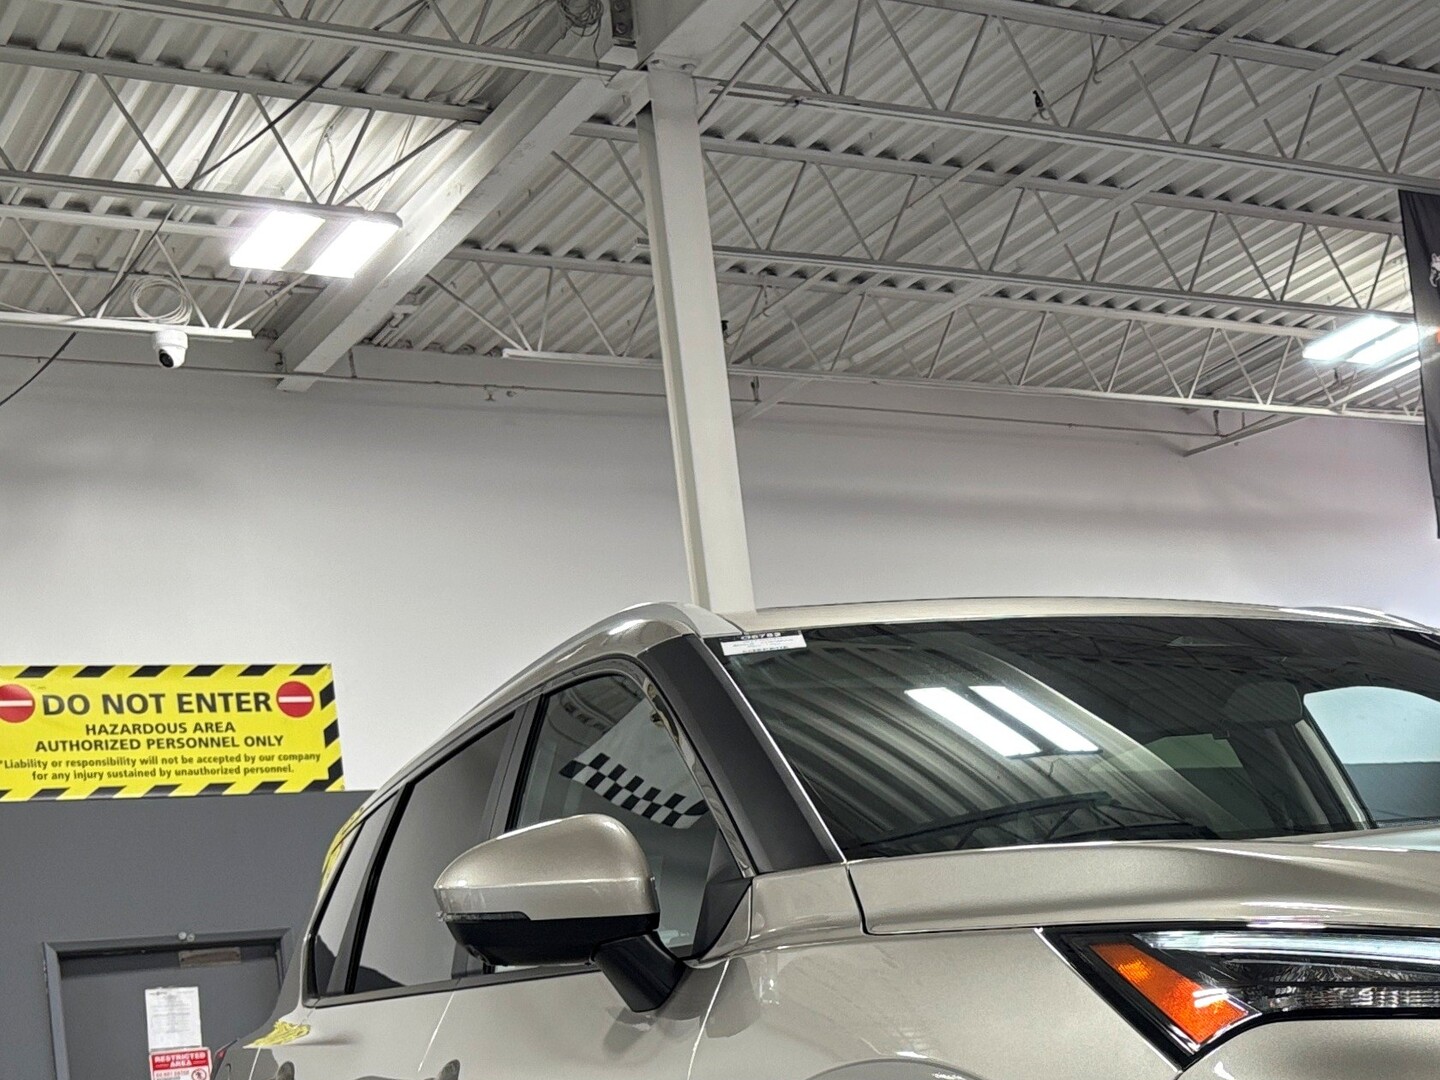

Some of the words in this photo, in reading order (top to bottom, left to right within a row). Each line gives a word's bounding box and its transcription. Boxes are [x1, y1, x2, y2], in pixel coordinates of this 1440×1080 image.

[43, 694, 90, 715] DO
[103, 693, 165, 715] NOT
[178, 692, 272, 713] ENTER
[85, 722, 187, 736] HAZARDOUS
[193, 722, 235, 734] AREA
[35, 738, 141, 752] AUTHORIZED
[147, 737, 239, 750] PERSONNEL
[244, 735, 284, 747] ONLY
[66, 757, 136, 768] responsibility
[140, 754, 158, 764] will
[162, 755, 178, 764] not
[181, 754, 194, 764] be
[197, 753, 242, 766] accepted
[244, 753, 256, 764] by
[278, 753, 321, 763] company
[32, 771, 48, 780] for
[51, 772, 70, 782] any
[73, 770, 104, 782] injury
[107, 768, 156, 778] sustained
[159, 768, 171, 778] by
[175, 766, 240, 776] unauthorized
[154, 1052, 206, 1063] RESTRICTED
[170, 1060, 193, 1068] AREA
